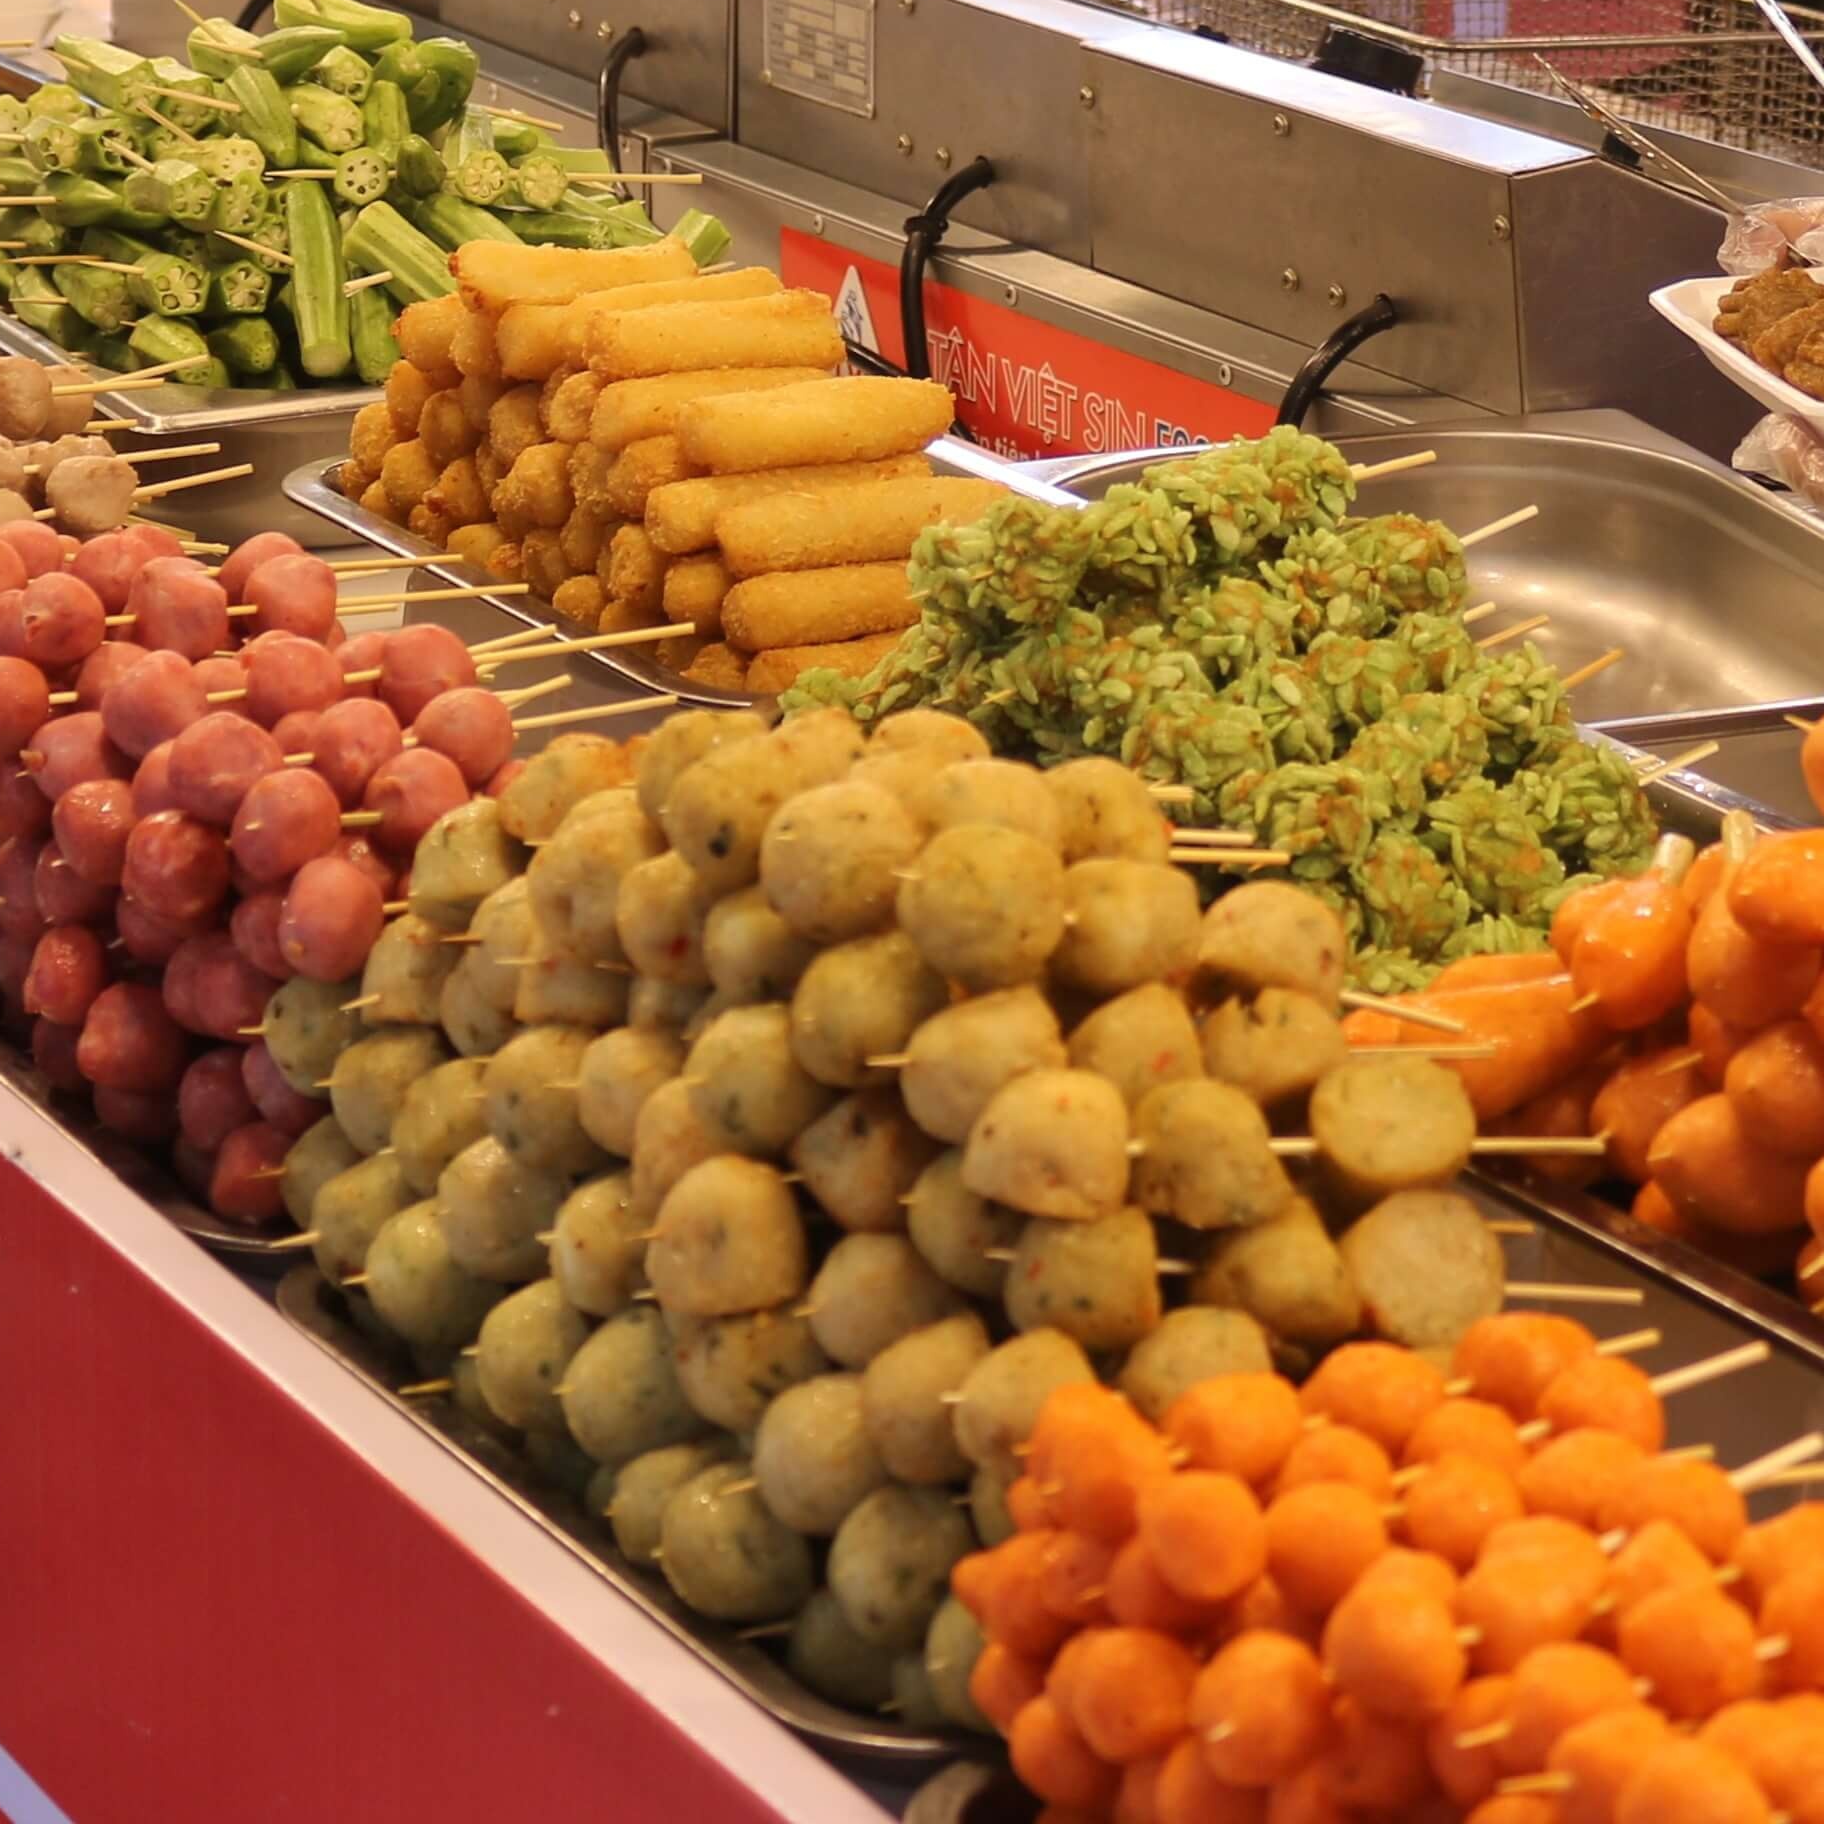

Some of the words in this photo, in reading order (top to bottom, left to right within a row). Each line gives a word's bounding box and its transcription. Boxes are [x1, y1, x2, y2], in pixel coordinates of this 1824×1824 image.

[926, 325, 997, 415] TÂN
[1001, 361, 1078, 445] VIỆT
[1082, 392, 1146, 453] SIN
